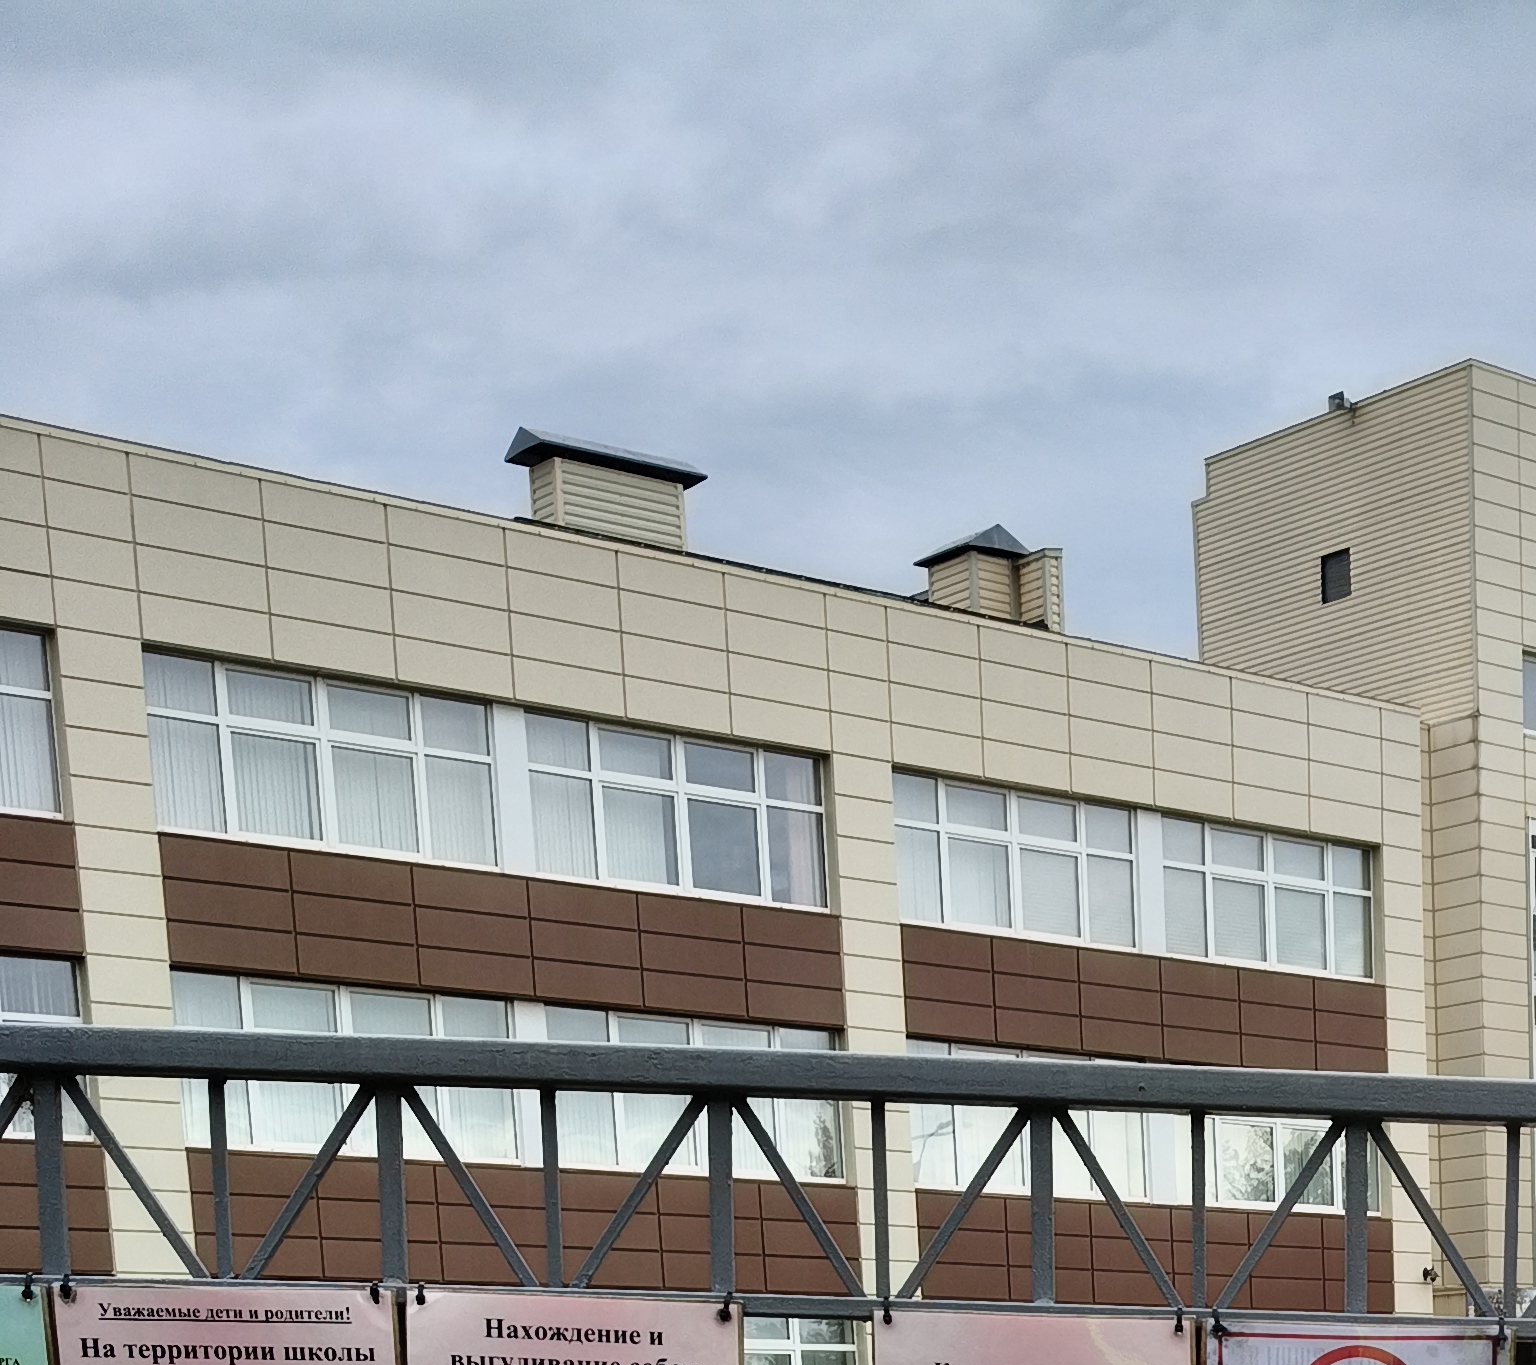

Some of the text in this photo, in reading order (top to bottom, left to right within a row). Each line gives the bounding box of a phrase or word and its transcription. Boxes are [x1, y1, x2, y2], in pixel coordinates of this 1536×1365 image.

[97, 1302, 351, 1321] Уважаемые дети и родители!
[483, 1317, 664, 1346] Нахождение и
[78, 1337, 376, 1365] На территории школы
